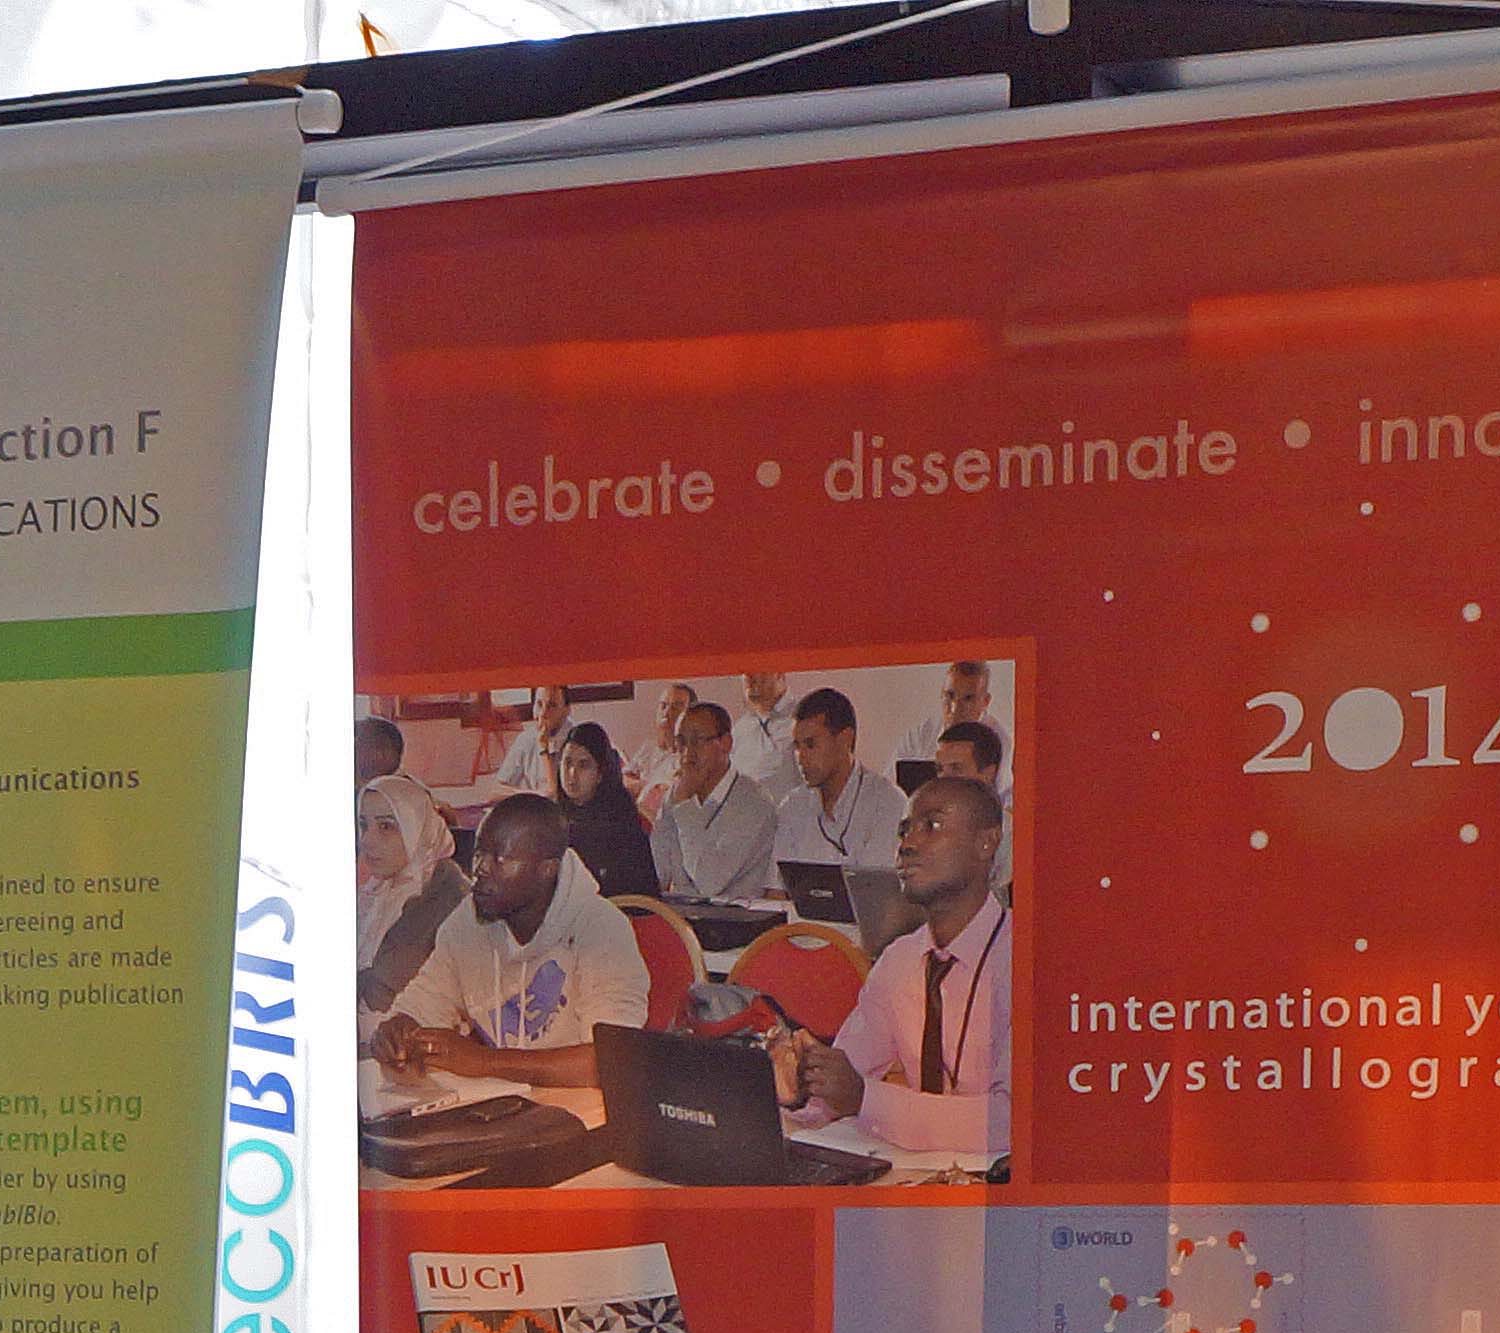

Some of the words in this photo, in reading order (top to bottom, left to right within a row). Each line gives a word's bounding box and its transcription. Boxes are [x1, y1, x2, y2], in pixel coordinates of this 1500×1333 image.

[138, 410, 160, 451] F
[414, 454, 714, 533] celebrate
[825, 419, 1236, 501] disseminate
[1071, 984, 1440, 1031] international
[659, 1103, 715, 1126] TOSHIBA
[1075, 1231, 1133, 1247] WORLD
